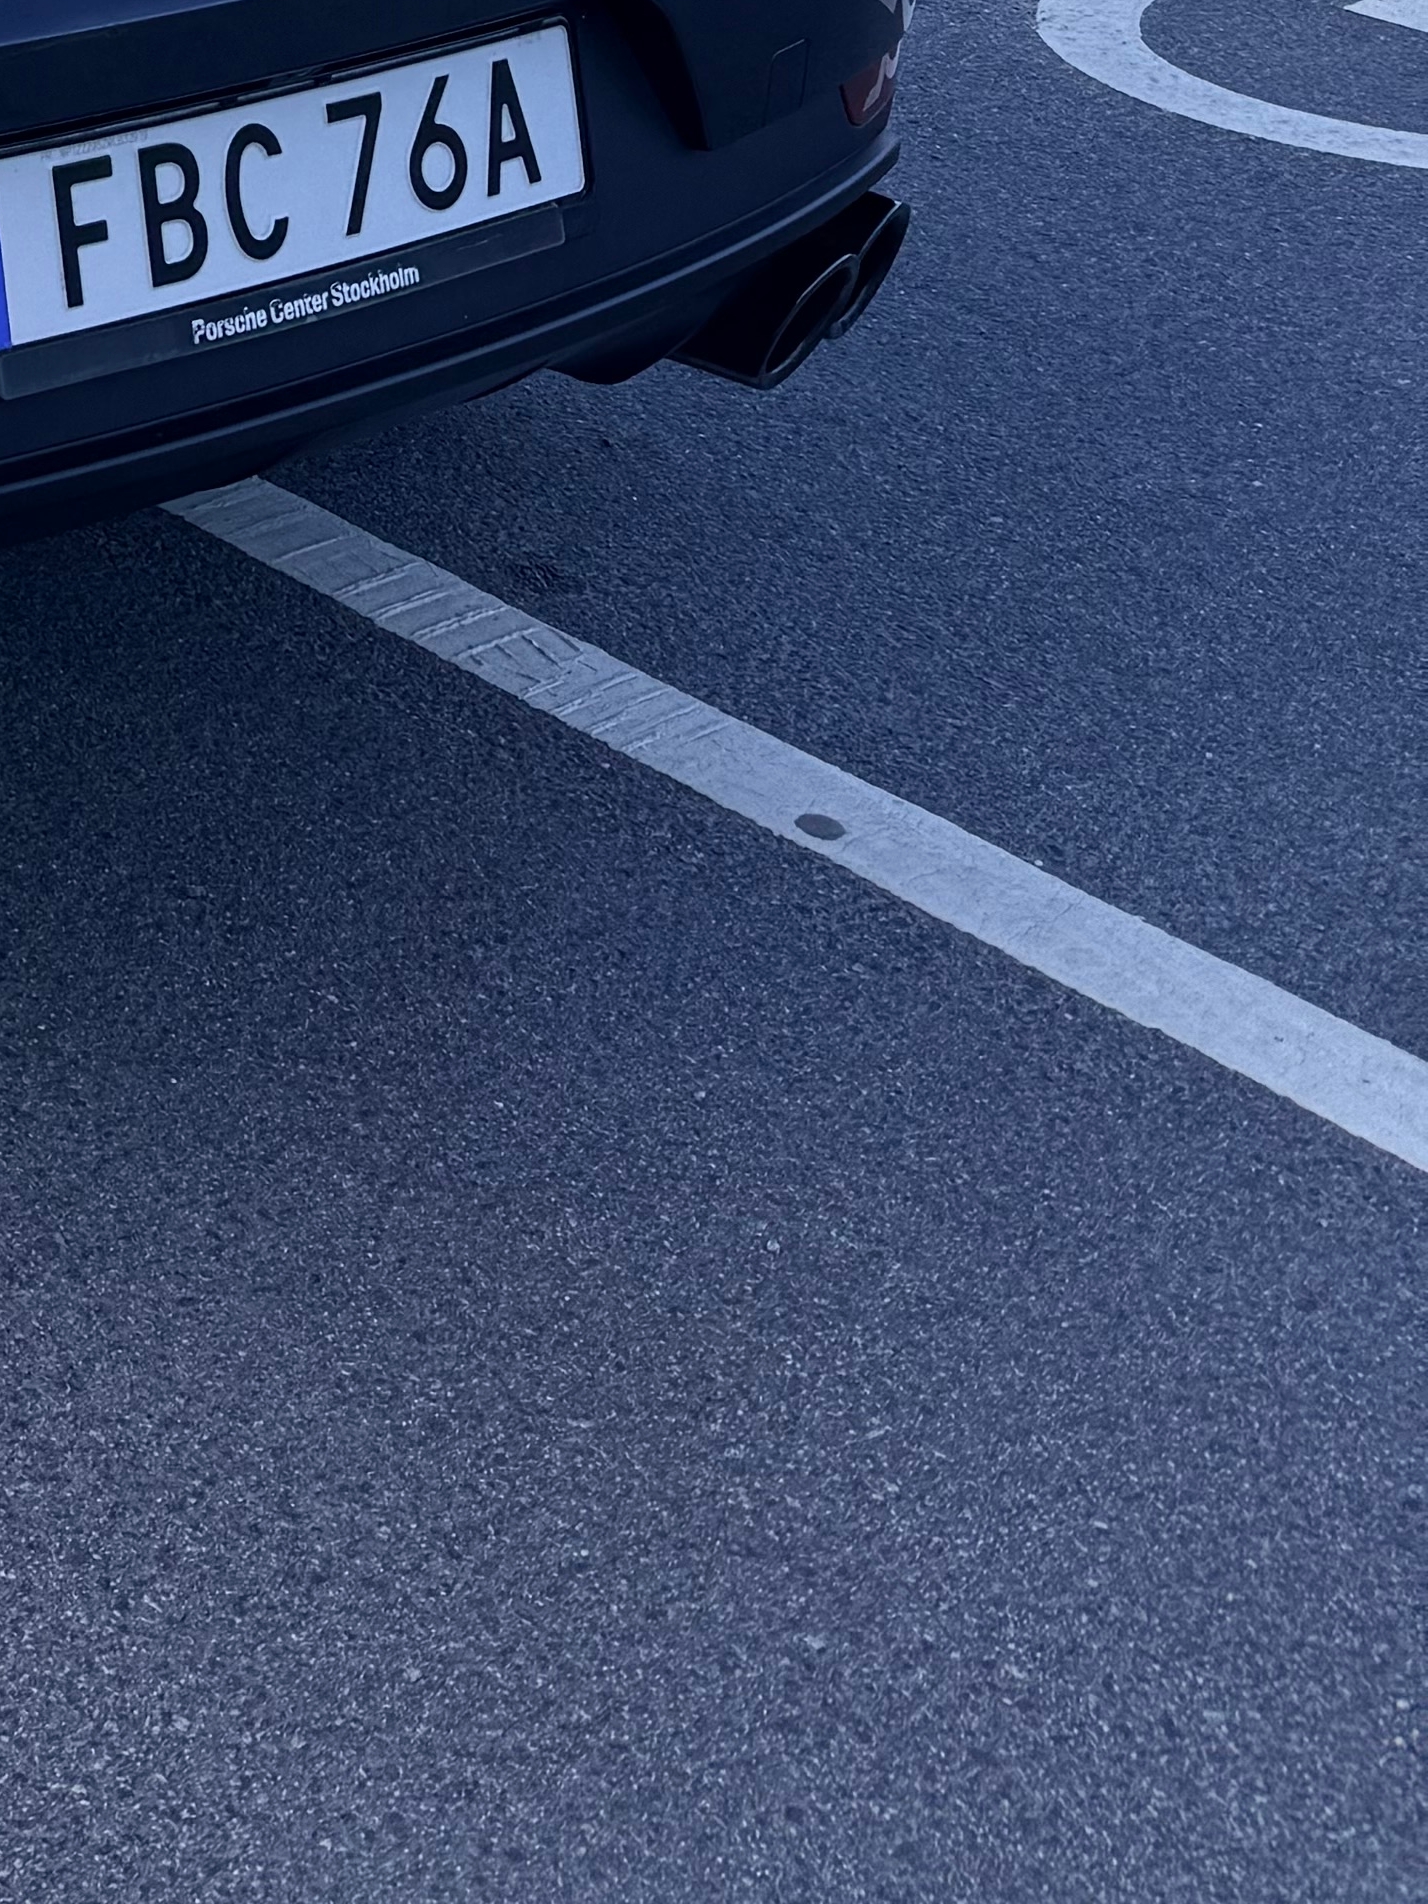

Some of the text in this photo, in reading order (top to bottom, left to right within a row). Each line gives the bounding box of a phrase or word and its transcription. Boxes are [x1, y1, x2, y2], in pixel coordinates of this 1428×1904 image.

[50, 57, 543, 309] FBC 76A
[191, 263, 420, 344] Porsche Center Stockholm
